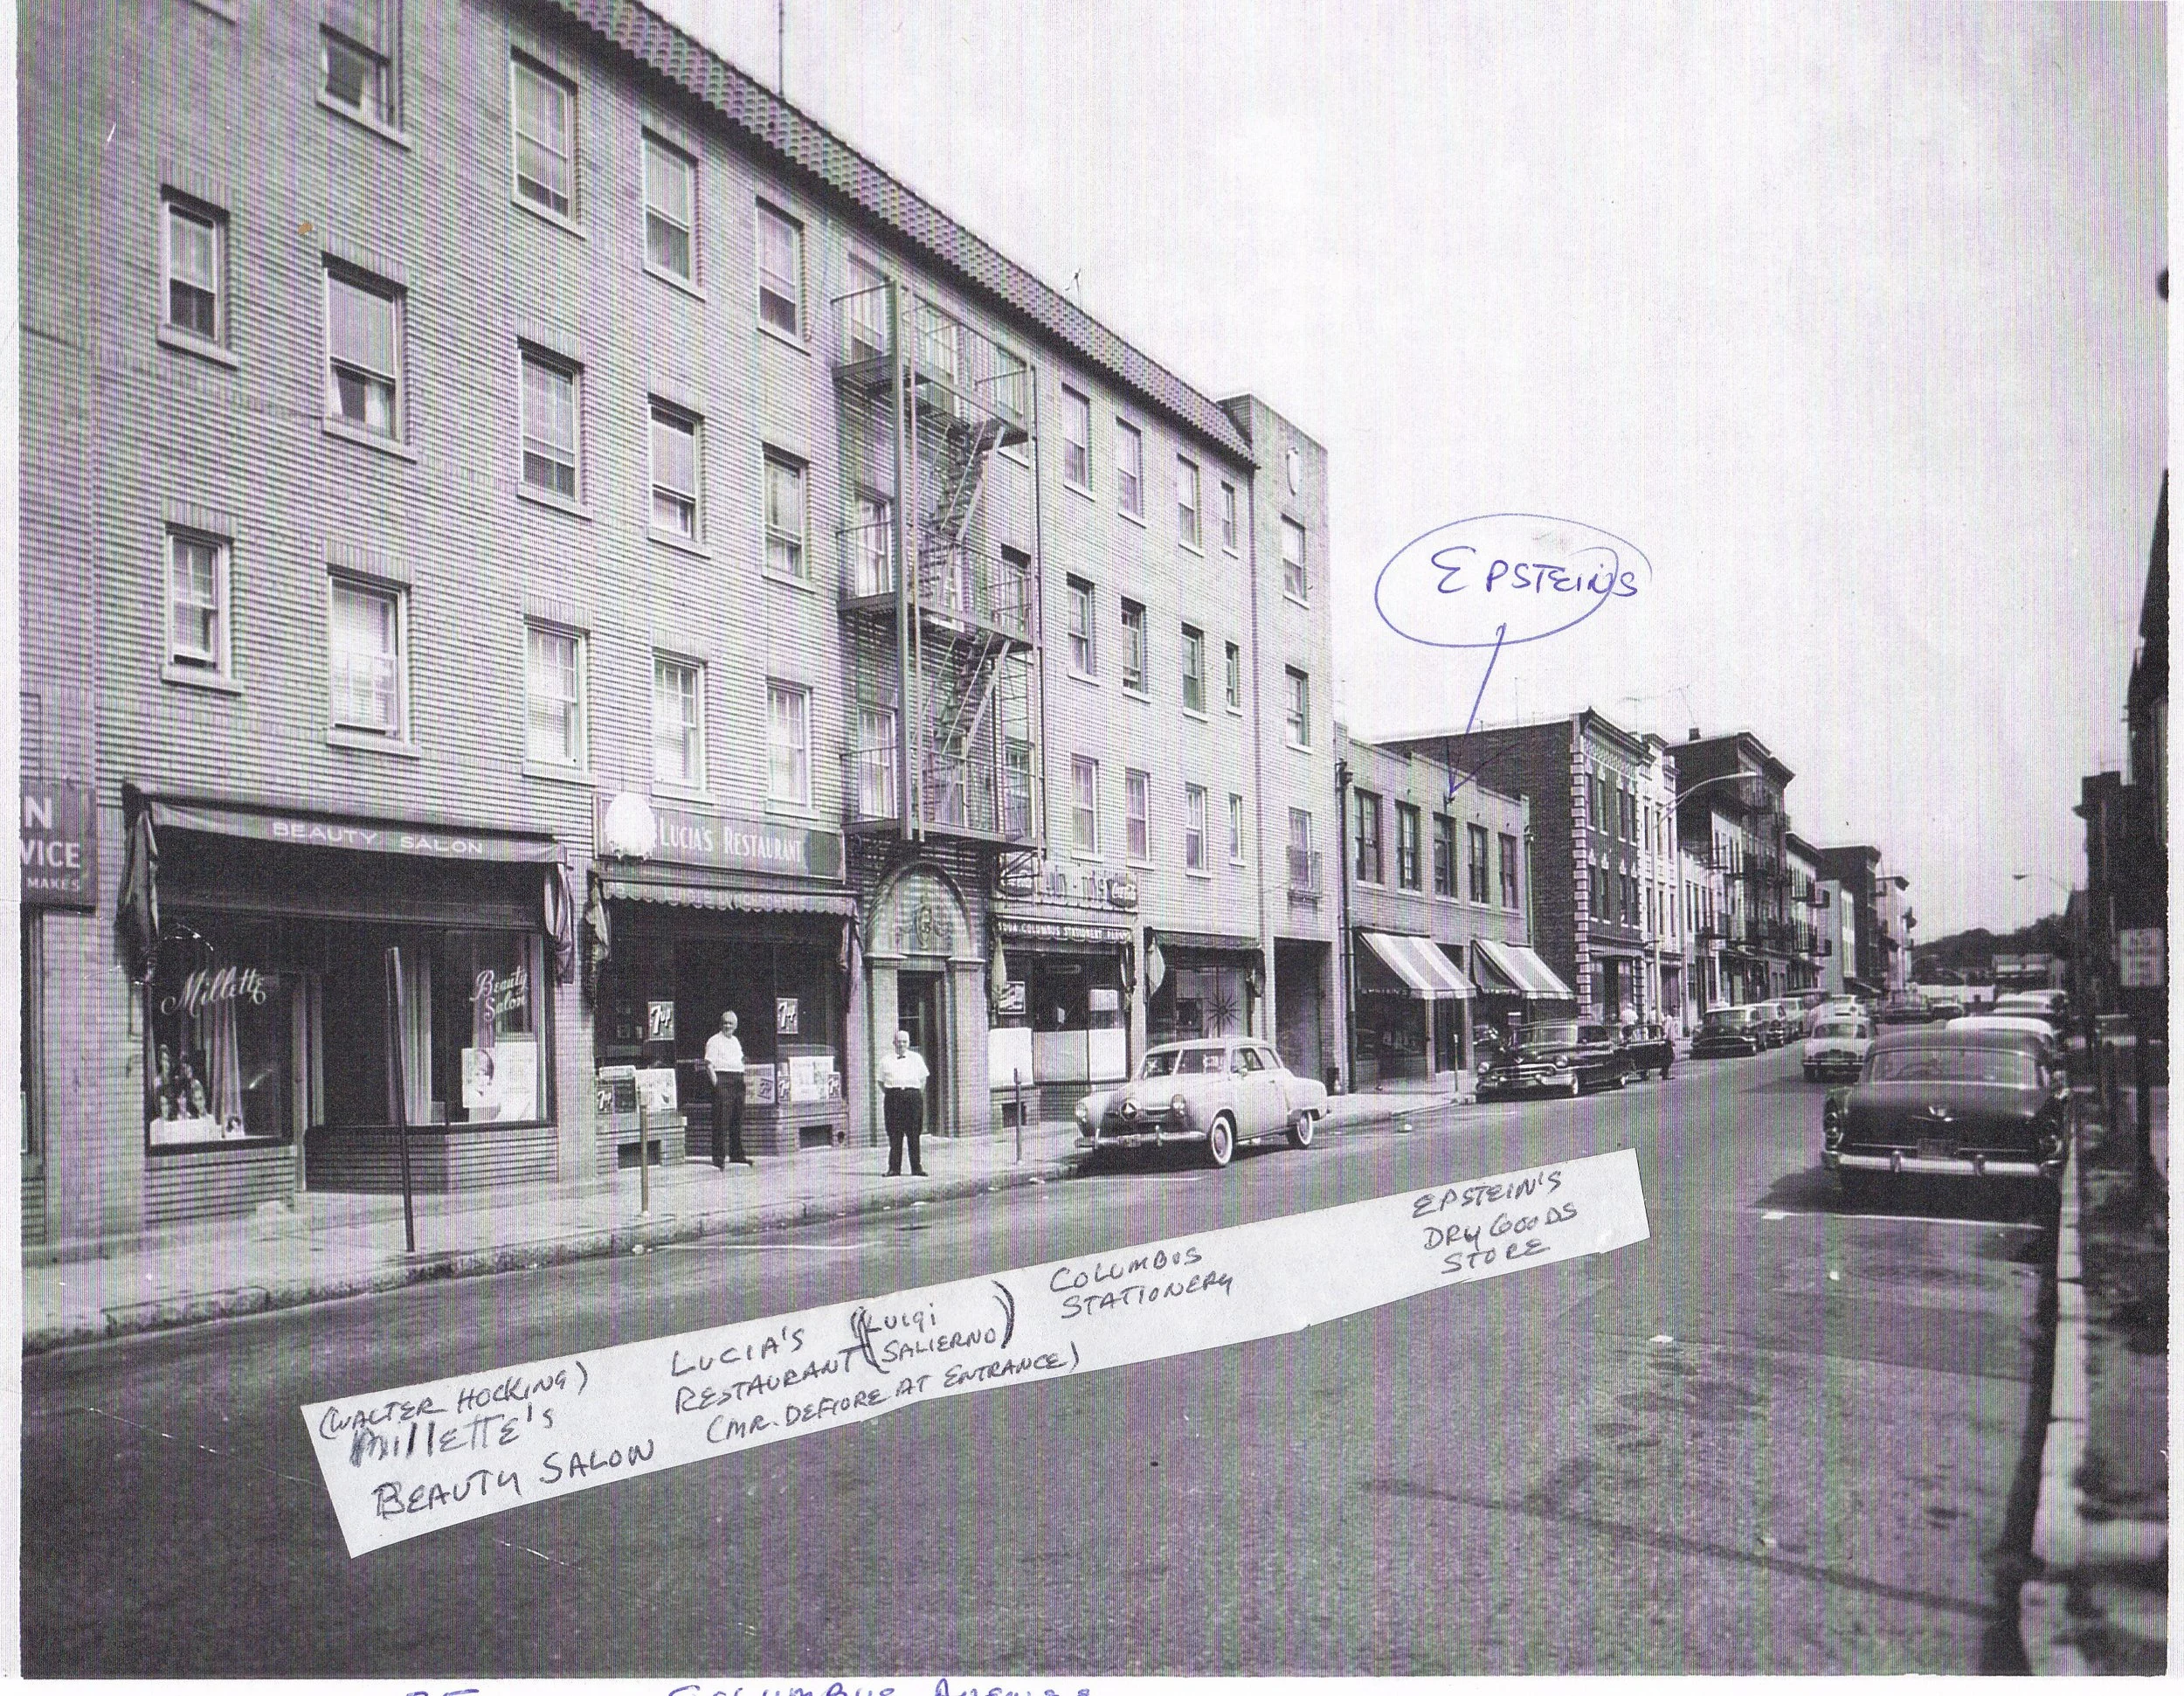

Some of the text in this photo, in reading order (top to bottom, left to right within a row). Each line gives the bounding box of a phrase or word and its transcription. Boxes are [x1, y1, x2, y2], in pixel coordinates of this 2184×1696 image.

[21, 839, 80, 868] VICE
[273, 820, 481, 854] BEAUTY SALON
[660, 816, 800, 862] LUCIA'S RESTAURANT
[27, 877, 80, 891] MAKES
[469, 965, 529, 999] Beauty
[484, 990, 526, 1022] Salon
[1412, 1169, 1564, 1221] EPSTEIN'S
[1422, 1201, 1579, 1251] DRY GOODS
[1048, 1246, 1204, 1293] COLUMBUS
[1441, 1237, 1551, 1276] STORE
[1060, 1273, 1234, 1320] STATIONERY
[670, 1326, 805, 1378] LUCIA'S
[674, 1343, 867, 1416] RESTAURANT
[785, 1388, 893, 1427] DEFIORE
[895, 1374, 930, 1398] AT
[371, 1437, 654, 1521] BEAUTY SALON
